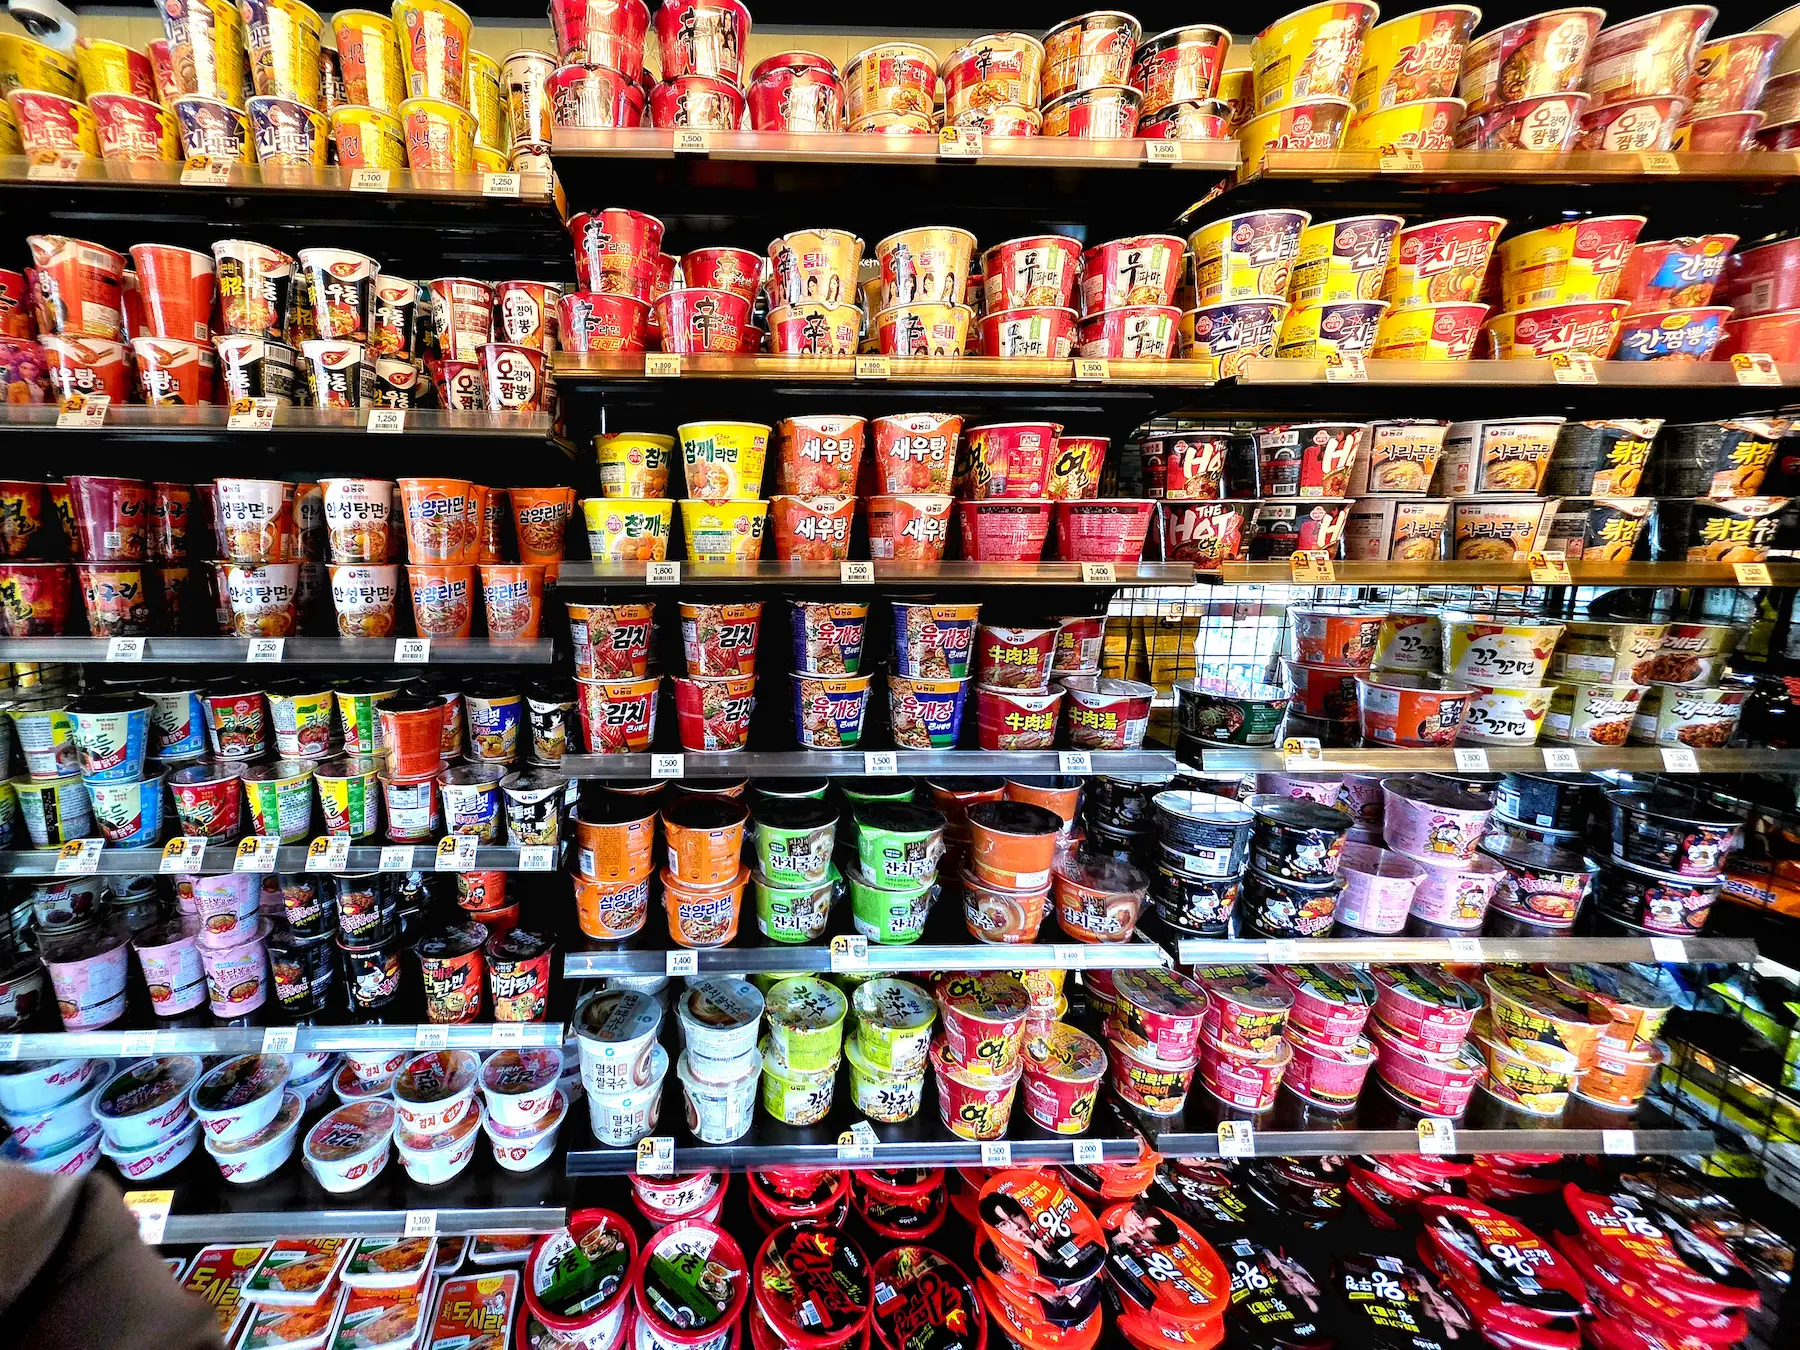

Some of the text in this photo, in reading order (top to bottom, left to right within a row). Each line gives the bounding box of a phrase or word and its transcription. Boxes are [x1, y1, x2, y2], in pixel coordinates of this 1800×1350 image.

[977, 46, 993, 82] 辛
[1393, 41, 1463, 75] 진짬뽕
[1555, 45, 1580, 63] 짬뽕
[1532, 107, 1568, 130] 오징어
[1613, 112, 1657, 137] 오징어
[184, 129, 240, 158] 진라면
[681, 135, 703, 144] 1,500
[1530, 125, 1561, 146] 짬뽕
[1615, 132, 1649, 151] 짬뽕
[1153, 144, 1175, 154] 1,800
[359, 173, 382, 183] 1,100
[491, 178, 513, 187] 1,250
[1018, 250, 1058, 295] 무파마
[1120, 250, 1161, 295] 무파마
[326, 284, 358, 305] 우동
[376, 306, 404, 328] 우동
[693, 297, 724, 349] 辛
[803, 311, 830, 354] 辛
[1209, 320, 1274, 357] 진라면
[1533, 316, 1615, 359] 진라면
[1633, 325, 1705, 355] 간짬뽕
[496, 358, 532, 382] 오징어
[863, 362, 882, 370] 1,800
[1081, 363, 1103, 372] 1,800
[499, 381, 529, 401] 짬뽕
[376, 414, 398, 422] 1,250
[684, 439, 738, 464] 참깨 라면
[800, 436, 855, 463] 새우탕
[889, 435, 948, 461] 새우탕
[1379, 444, 1442, 461] 사리곰탕
[1607, 441, 1649, 465] 튀김
[1728, 441, 1774, 465] 튀김
[1055, 450, 1091, 490] 열
[326, 502, 385, 520] 안성탕면
[407, 494, 466, 520] 삼양라면
[519, 500, 566, 524] 삼양라면
[1195, 503, 1223, 517] THE
[794, 516, 848, 541] 새우탕
[1170, 511, 1236, 543] HOT
[1459, 520, 1534, 539] 사리곰탕
[653, 566, 673, 576] 1,800
[848, 566, 867, 575] 1,500
[1090, 567, 1109, 576] 1,400
[229, 585, 289, 604] 안성탕면
[334, 584, 391, 604] 안성탕면
[413, 578, 467, 604] 삼양라면
[612, 624, 649, 650] 김치
[718, 623, 756, 650] 김치
[816, 622, 863, 647] 육개장
[918, 623, 971, 650] 육개장
[116, 642, 137, 652] 1,250
[256, 643, 277, 652] 1,250
[403, 643, 423, 653] 1,100
[988, 645, 1040, 667] 牛肉湯
[1630, 636, 1709, 657] 짜파게티
[1472, 647, 1535, 676] 꼬꼬면
[604, 698, 647, 725] 김치
[812, 696, 862, 721] 육개장
[901, 696, 954, 722] 육개장
[1067, 706, 1119, 731] 牛肉湯
[1004, 711, 1054, 732] 牛肉湯
[1465, 706, 1526, 735] 꼬꼬면
[658, 758, 678, 768] 1,500
[872, 756, 891, 766] 1,500
[1066, 756, 1085, 766] 1,500
[1551, 753, 1570, 762] 1,800
[454, 793, 489, 813] 누들핏
[168, 842, 185, 855] 3+1
[242, 841, 258, 854] 3+1
[312, 840, 330, 854] 3+1
[440, 841, 458, 855] 2+1
[769, 853, 822, 872] 잔치국수
[881, 858, 935, 877] 잔치국수
[598, 879, 649, 910] 삼양라면
[677, 893, 733, 920] 삼양라면
[773, 913, 824, 931] 잔치국수
[1063, 906, 1122, 933] 김치국수
[673, 956, 692, 966] 1,400
[423, 972, 464, 999] 탄탄면
[950, 978, 993, 1005] 열
[977, 1039, 1007, 1070] 열
[365, 1066, 381, 1078] 김치
[595, 1063, 617, 1077] 멸치
[595, 1076, 629, 1091] 쌀국수
[418, 1116, 437, 1128] 김치
[612, 1112, 633, 1126] 멸치
[960, 1104, 991, 1134] 열
[612, 1125, 644, 1139] 쌀국수
[840, 1134, 855, 1148] 2+1
[639, 1141, 656, 1157] 2+1
[987, 1147, 1005, 1156] 1,500
[1079, 1145, 1097, 1154] 2,000
[1289, 1163, 1316, 1178] paldo
[996, 1180, 1014, 1194] paldo
[412, 1216, 431, 1226] 1,100
[1037, 1195, 1080, 1238] 왕뚜껑
[1585, 1204, 1664, 1239] 왕뚜껑
[1176, 1228, 1200, 1251] paldo
[543, 1253, 580, 1282] 우동
[843, 1246, 859, 1268] paldo
[1489, 1243, 1556, 1277] 왕뚜껑
[1143, 1251, 1211, 1304] 왕뚜껑
[1345, 1270, 1406, 1300] 왕뚜껑
[452, 1301, 504, 1337] 도시락
[1293, 1323, 1316, 1337] paldo
